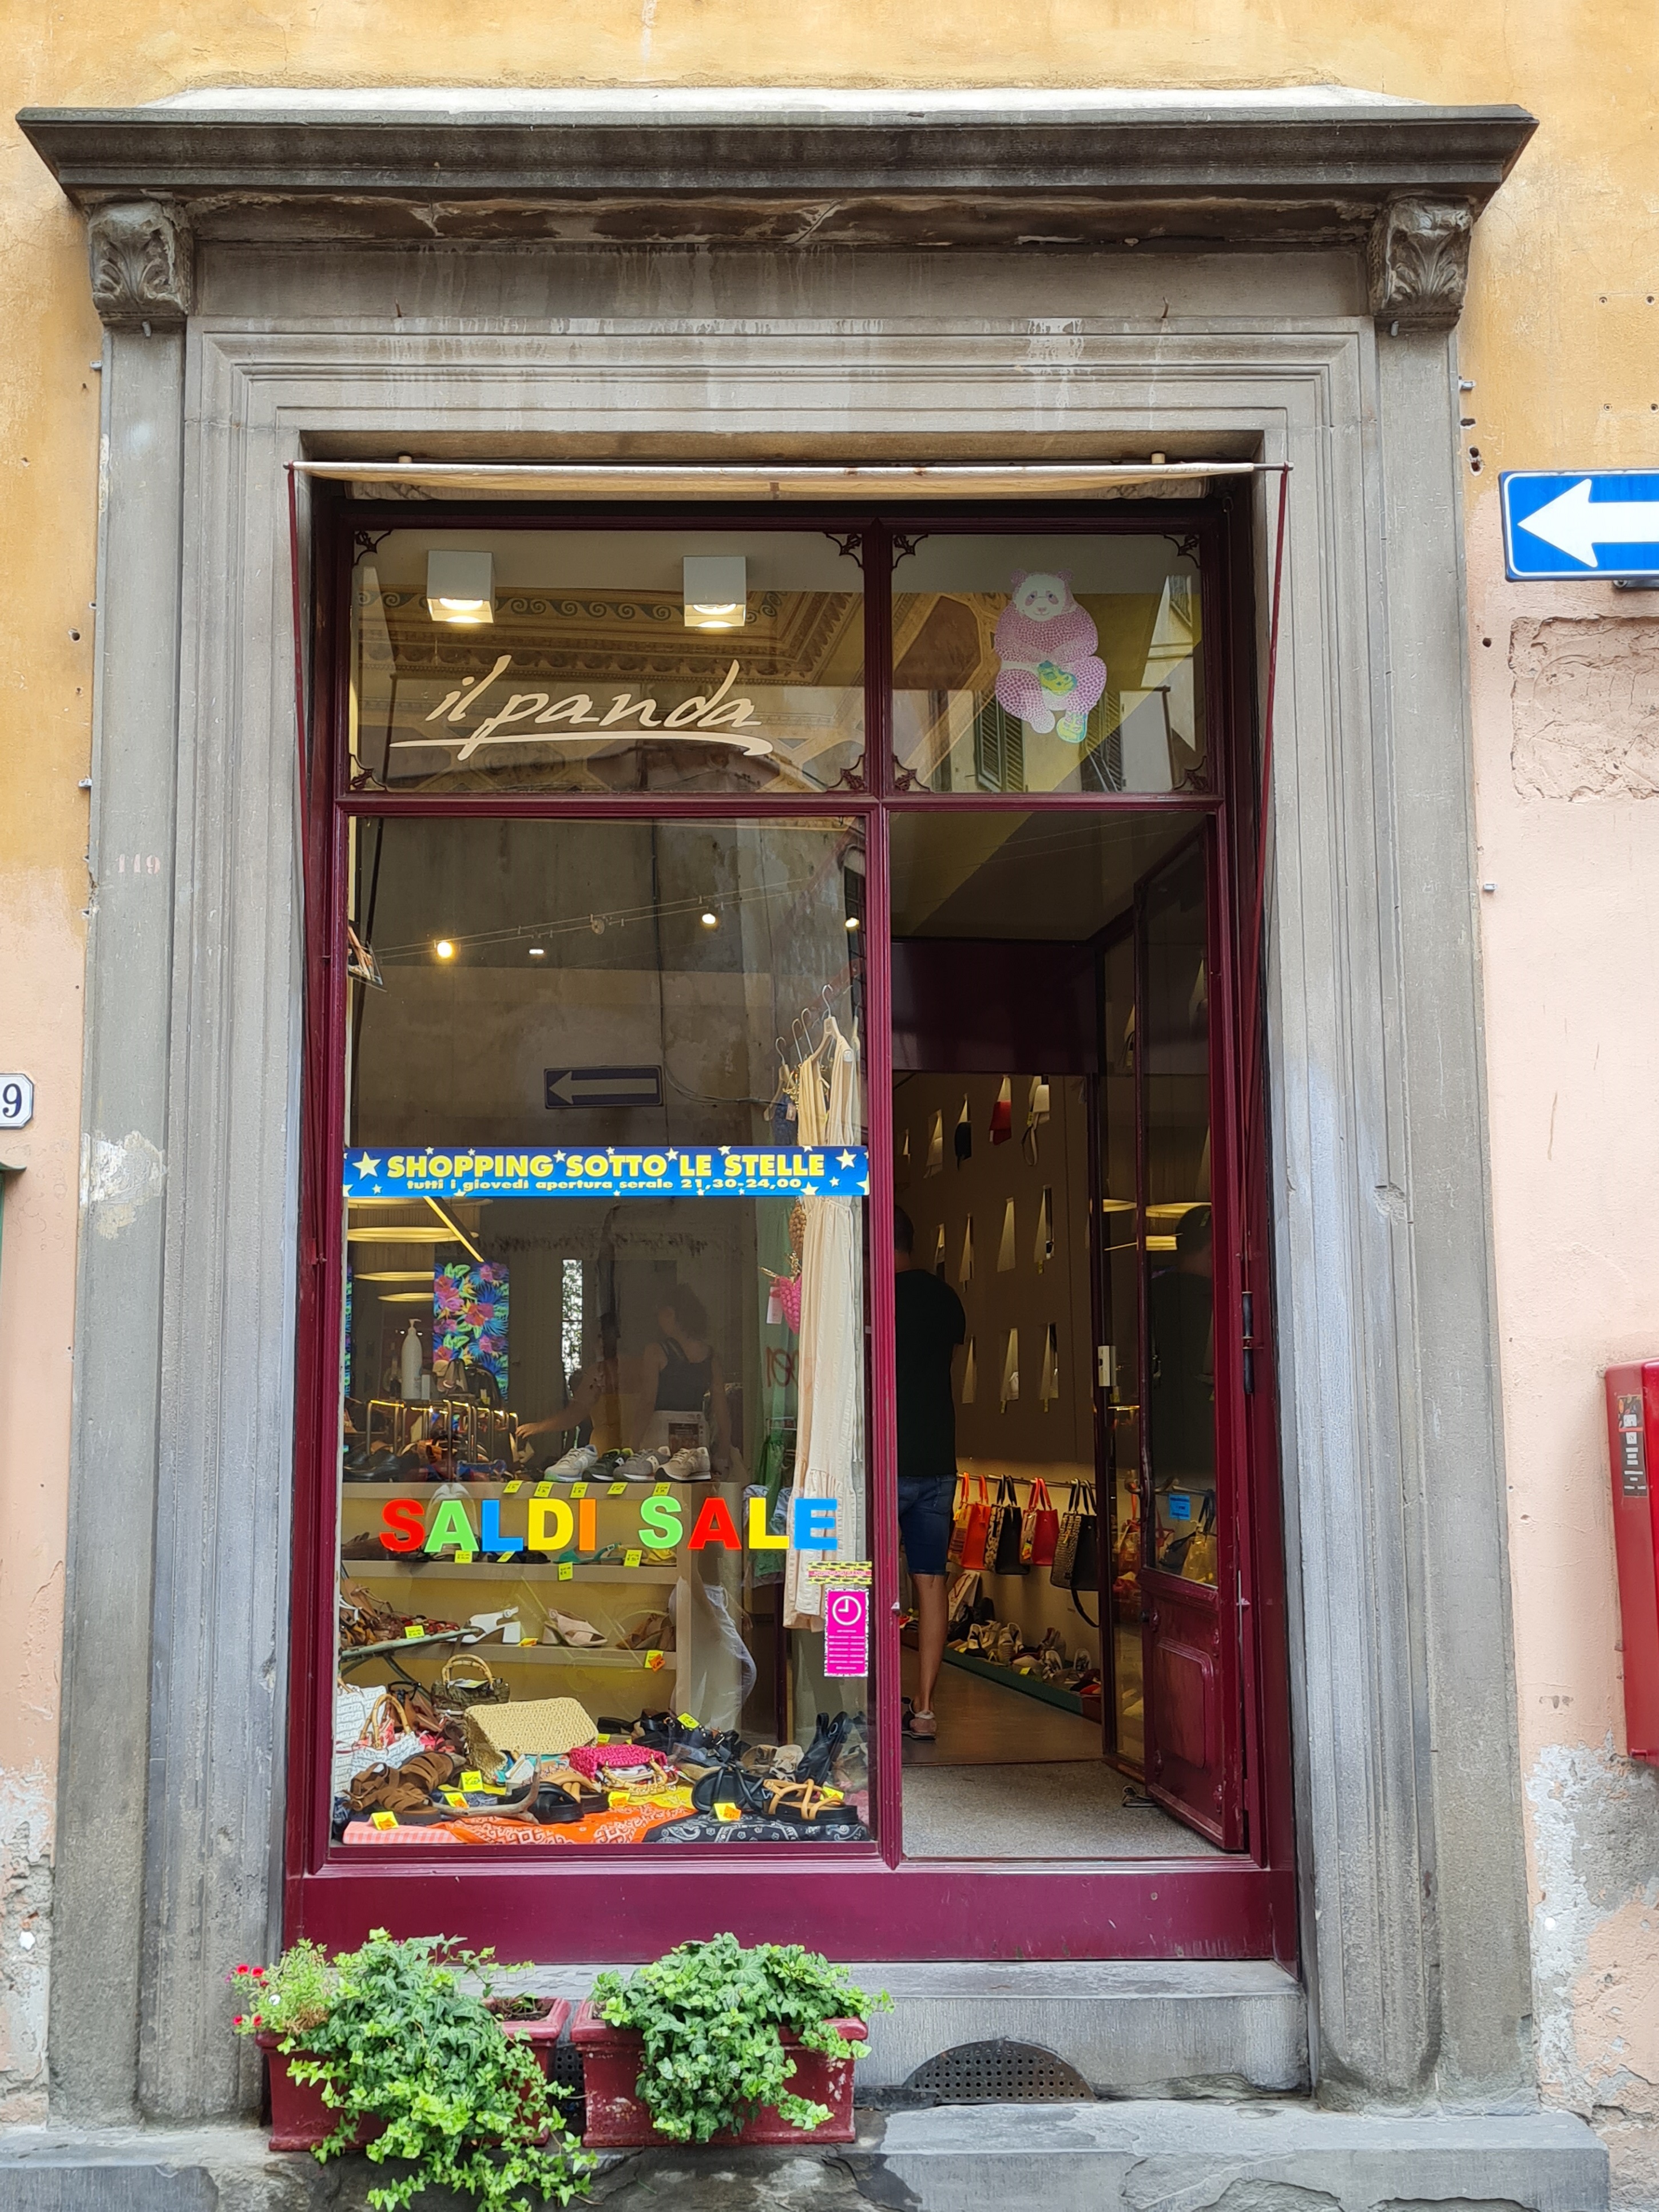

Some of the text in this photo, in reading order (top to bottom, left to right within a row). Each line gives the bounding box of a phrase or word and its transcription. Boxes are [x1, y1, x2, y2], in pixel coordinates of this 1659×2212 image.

[426, 655, 762, 760] il panda
[115, 853, 161, 875] 119
[387, 1154, 825, 1178] SHOPPING SOTTO LE STELLE
[406, 1179, 444, 1190] tutti
[450, 1179, 457, 1189] i
[535, 1180, 613, 1191] apertura
[619, 1178, 673, 1189] serale
[680, 1178, 802, 1191] 21,30-24,00
[379, 1495, 838, 1553] SALDI SALE
